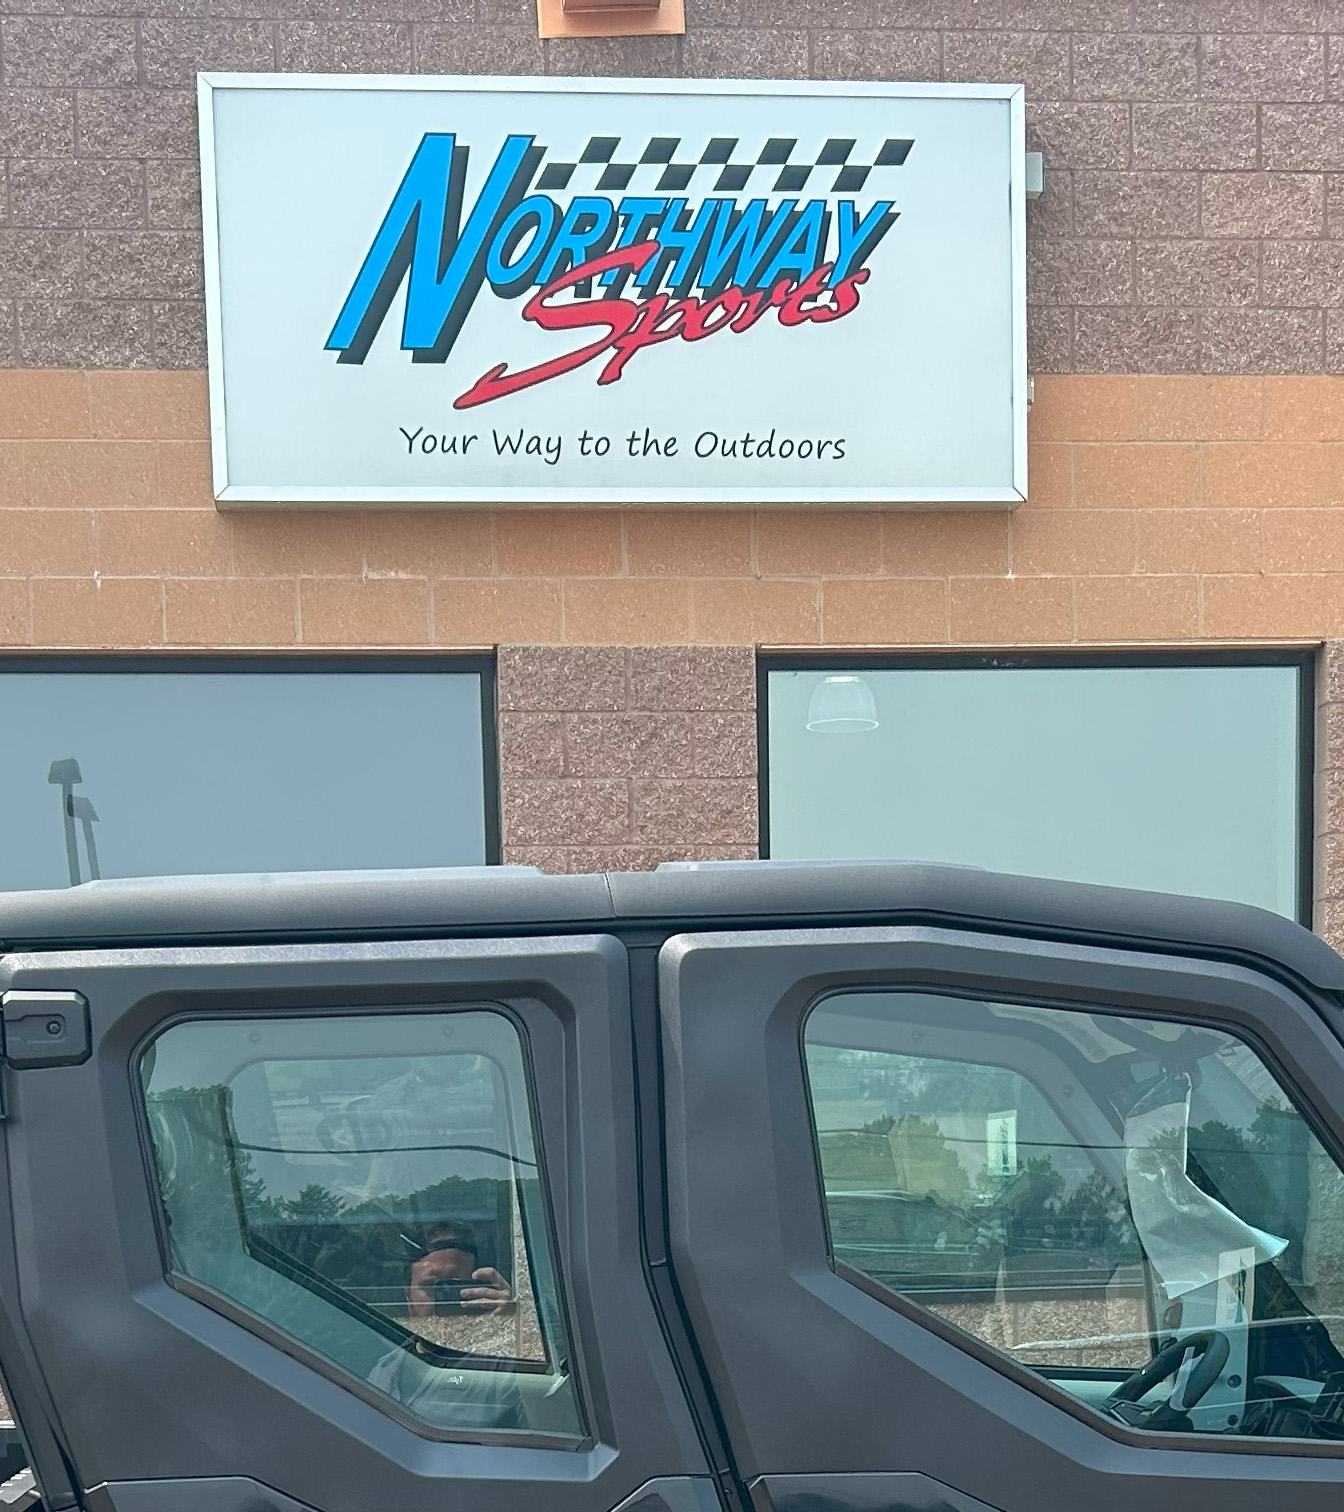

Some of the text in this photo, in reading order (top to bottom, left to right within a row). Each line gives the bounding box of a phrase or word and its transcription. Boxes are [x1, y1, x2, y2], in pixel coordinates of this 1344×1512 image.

[323, 131, 896, 354] NORTHWAY
[453, 240, 870, 410] Sports
[399, 426, 846, 466] Your Way to the Outdoors
